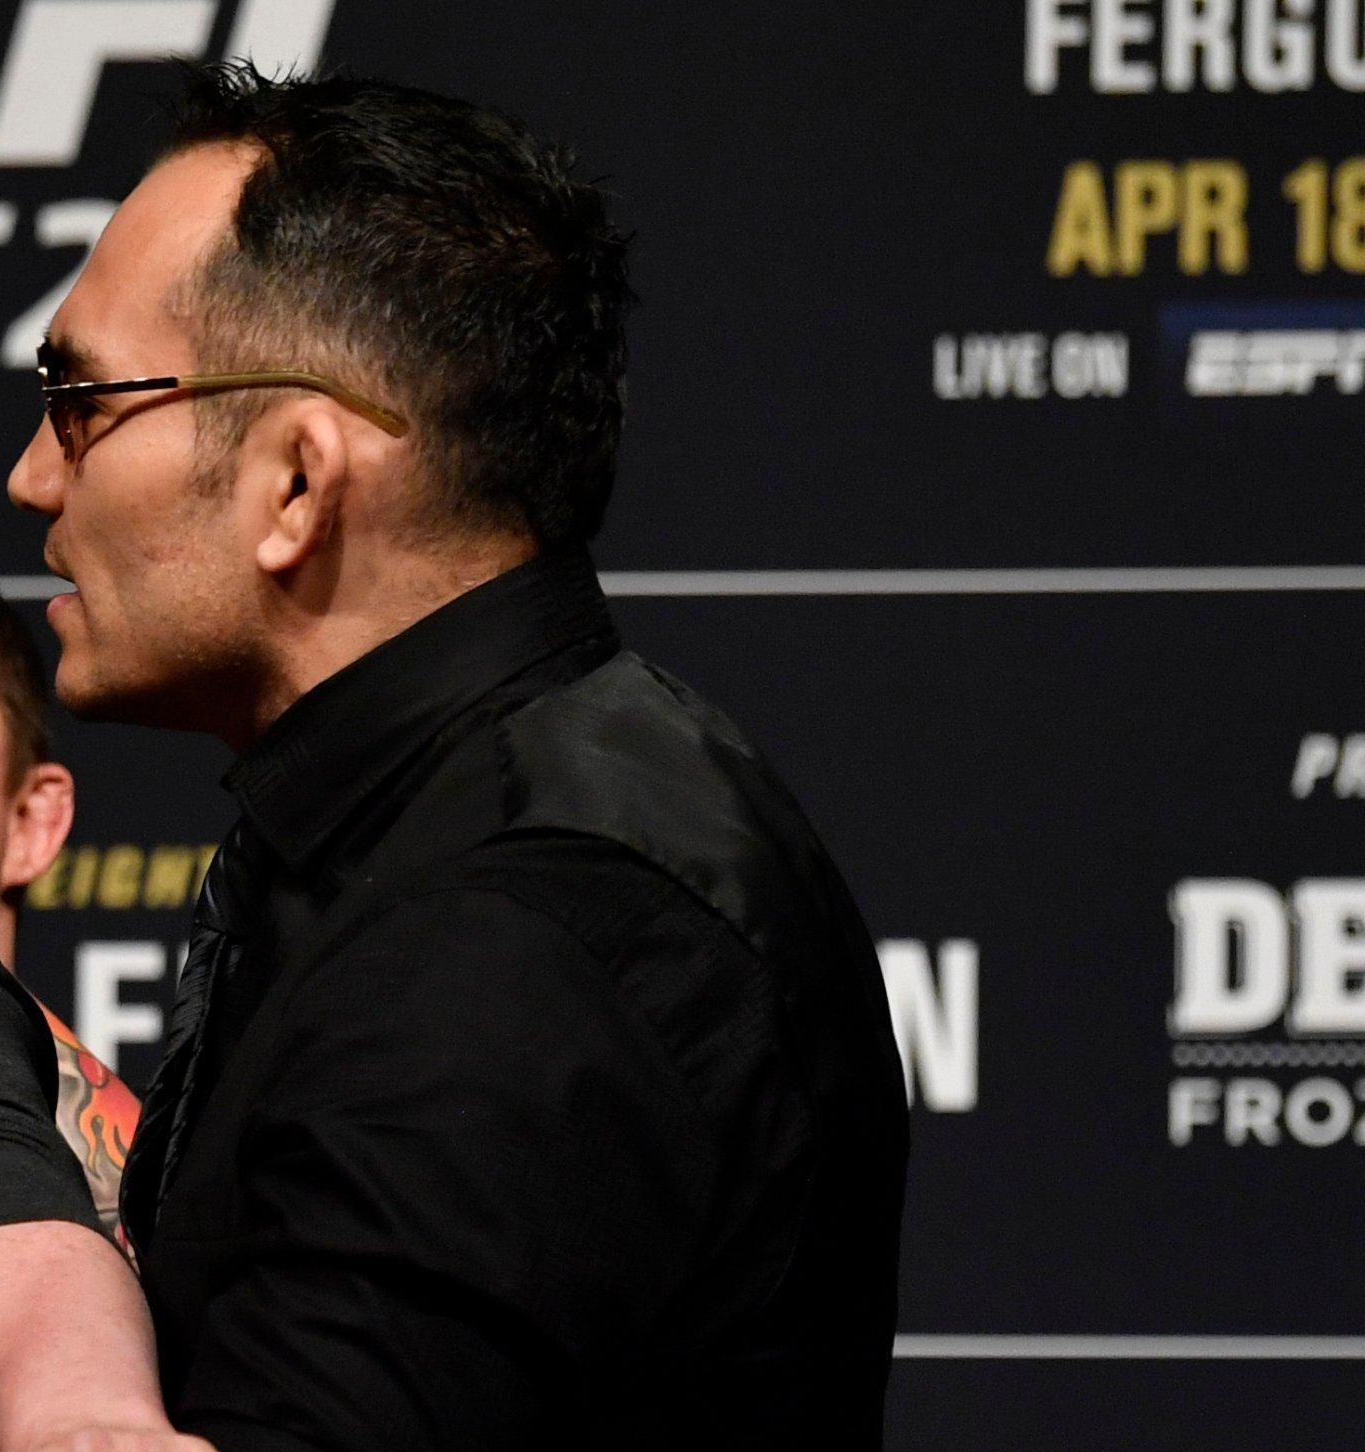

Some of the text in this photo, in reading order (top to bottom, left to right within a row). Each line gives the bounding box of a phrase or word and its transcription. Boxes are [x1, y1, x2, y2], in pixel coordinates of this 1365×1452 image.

[1045, 158, 1250, 277] APR
[932, 331, 1049, 400] LIVE
[1051, 330, 1130, 399] ON
[1169, 1076, 1365, 1148] FRO
